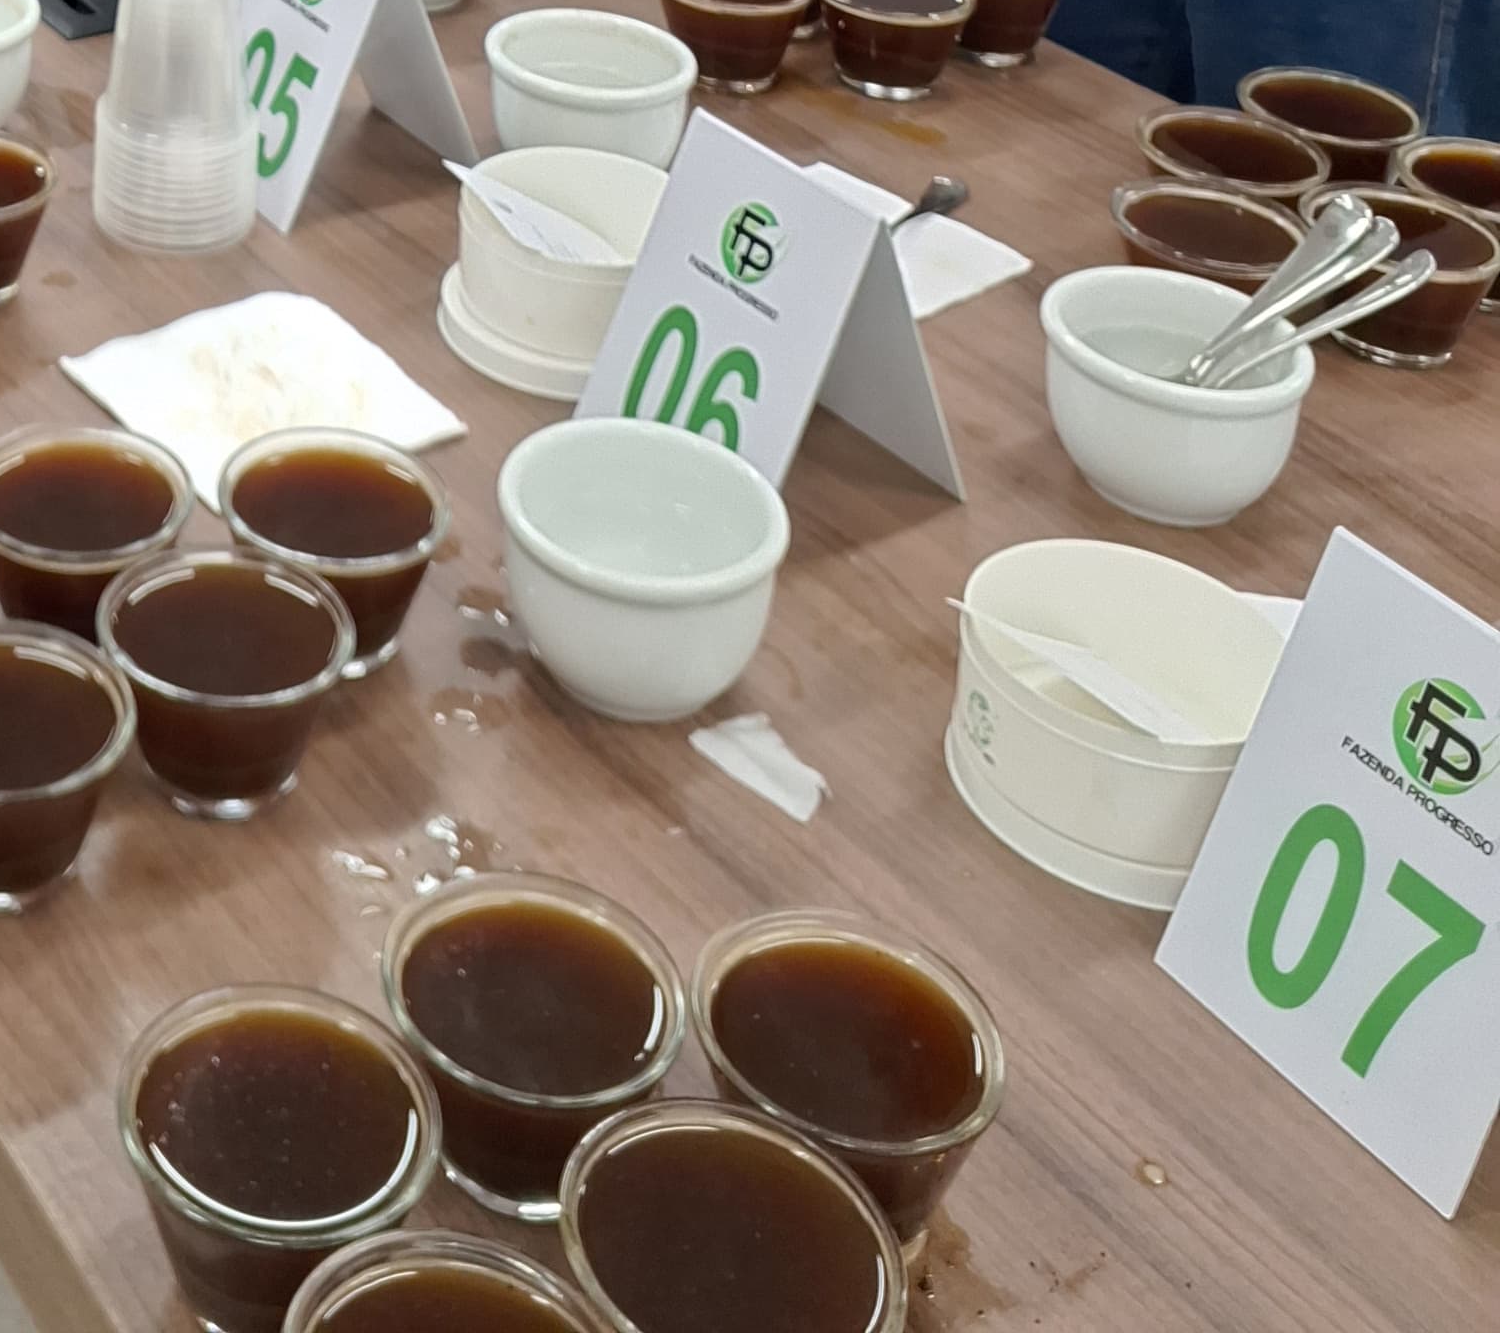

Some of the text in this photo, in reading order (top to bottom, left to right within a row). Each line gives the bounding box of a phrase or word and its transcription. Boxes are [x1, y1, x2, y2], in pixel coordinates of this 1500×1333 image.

[730, 208, 773, 277] FP
[623, 304, 760, 453] 06
[1406, 681, 1481, 783] FP
[1340, 735, 1494, 856] FAZENDA PROGRESSO
[1247, 803, 1486, 1079] 07
